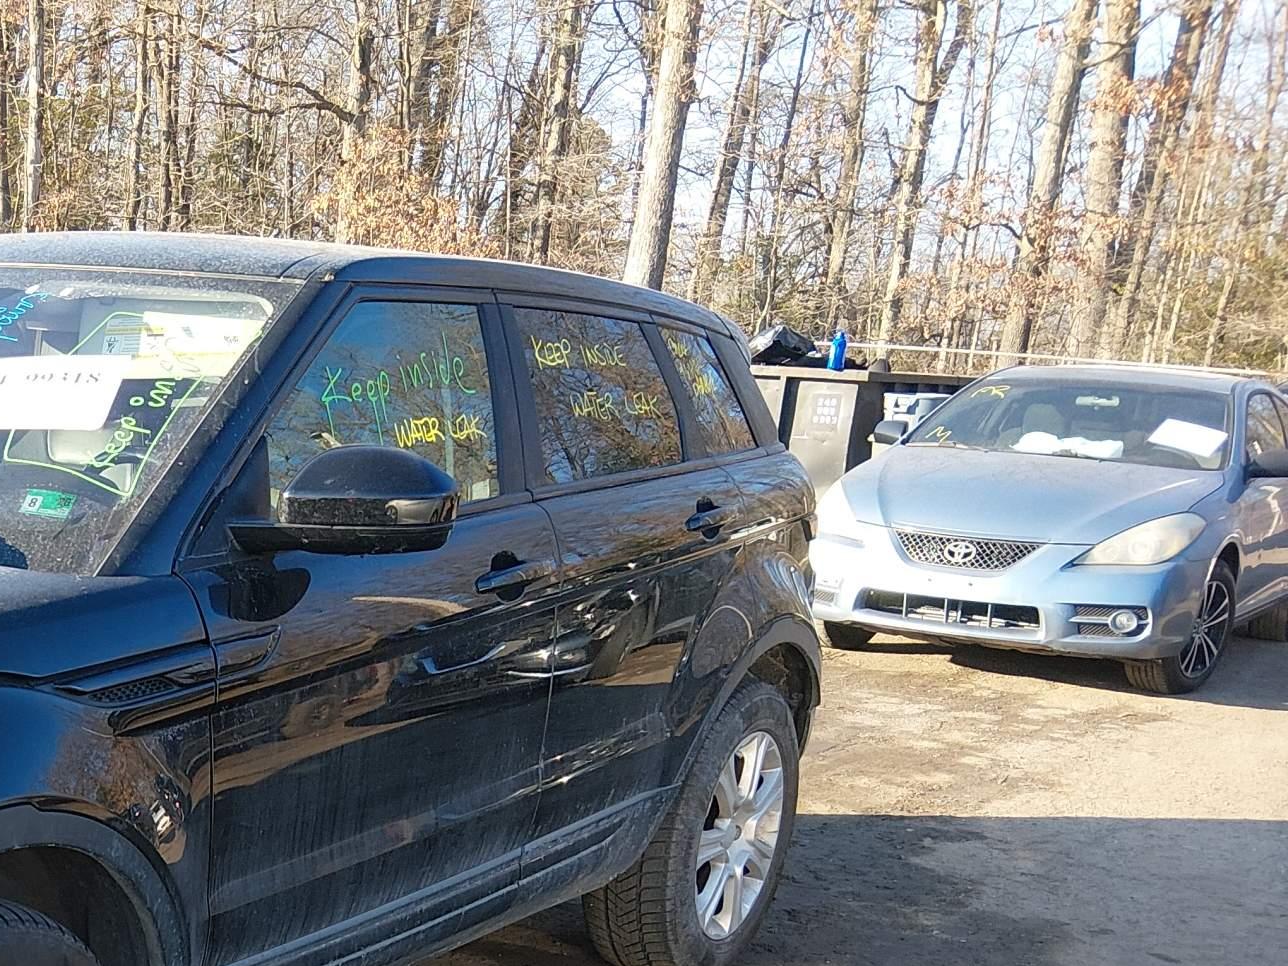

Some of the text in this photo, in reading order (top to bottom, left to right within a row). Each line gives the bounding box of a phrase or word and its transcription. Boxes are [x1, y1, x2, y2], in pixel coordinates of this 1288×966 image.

[530, 335, 627, 369] KEEP INSIDE
[321, 331, 477, 426] Keep inside
[570, 391, 664, 420] WATER LEAK
[394, 416, 445, 448] WATER
[28, 497, 39, 508] 8
